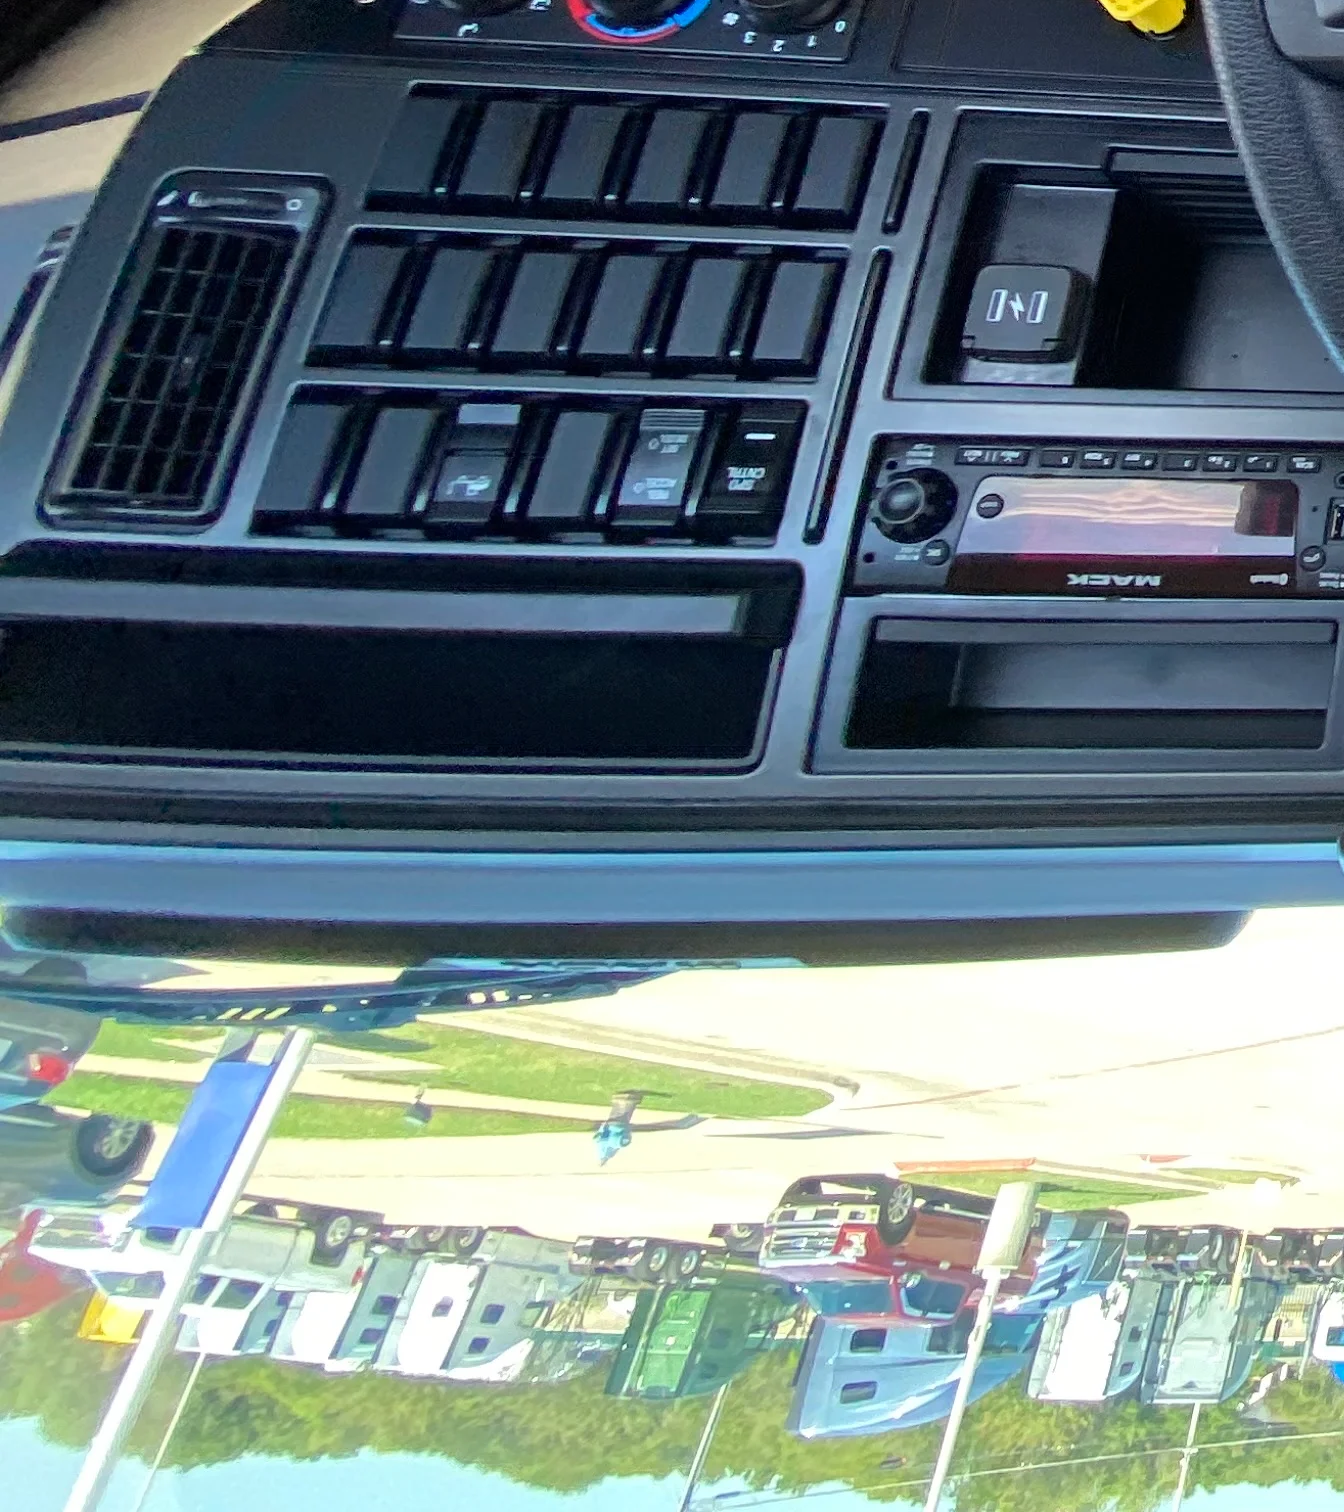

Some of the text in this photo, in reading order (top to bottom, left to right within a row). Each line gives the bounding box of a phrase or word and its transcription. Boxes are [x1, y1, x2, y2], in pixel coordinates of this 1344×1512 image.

[743, 31, 757, 44] 3
[806, 35, 817, 47] 1
[772, 39, 785, 52] 2
[727, 466, 766, 479] CNTRL
[1066, 573, 1162, 587] MACK
